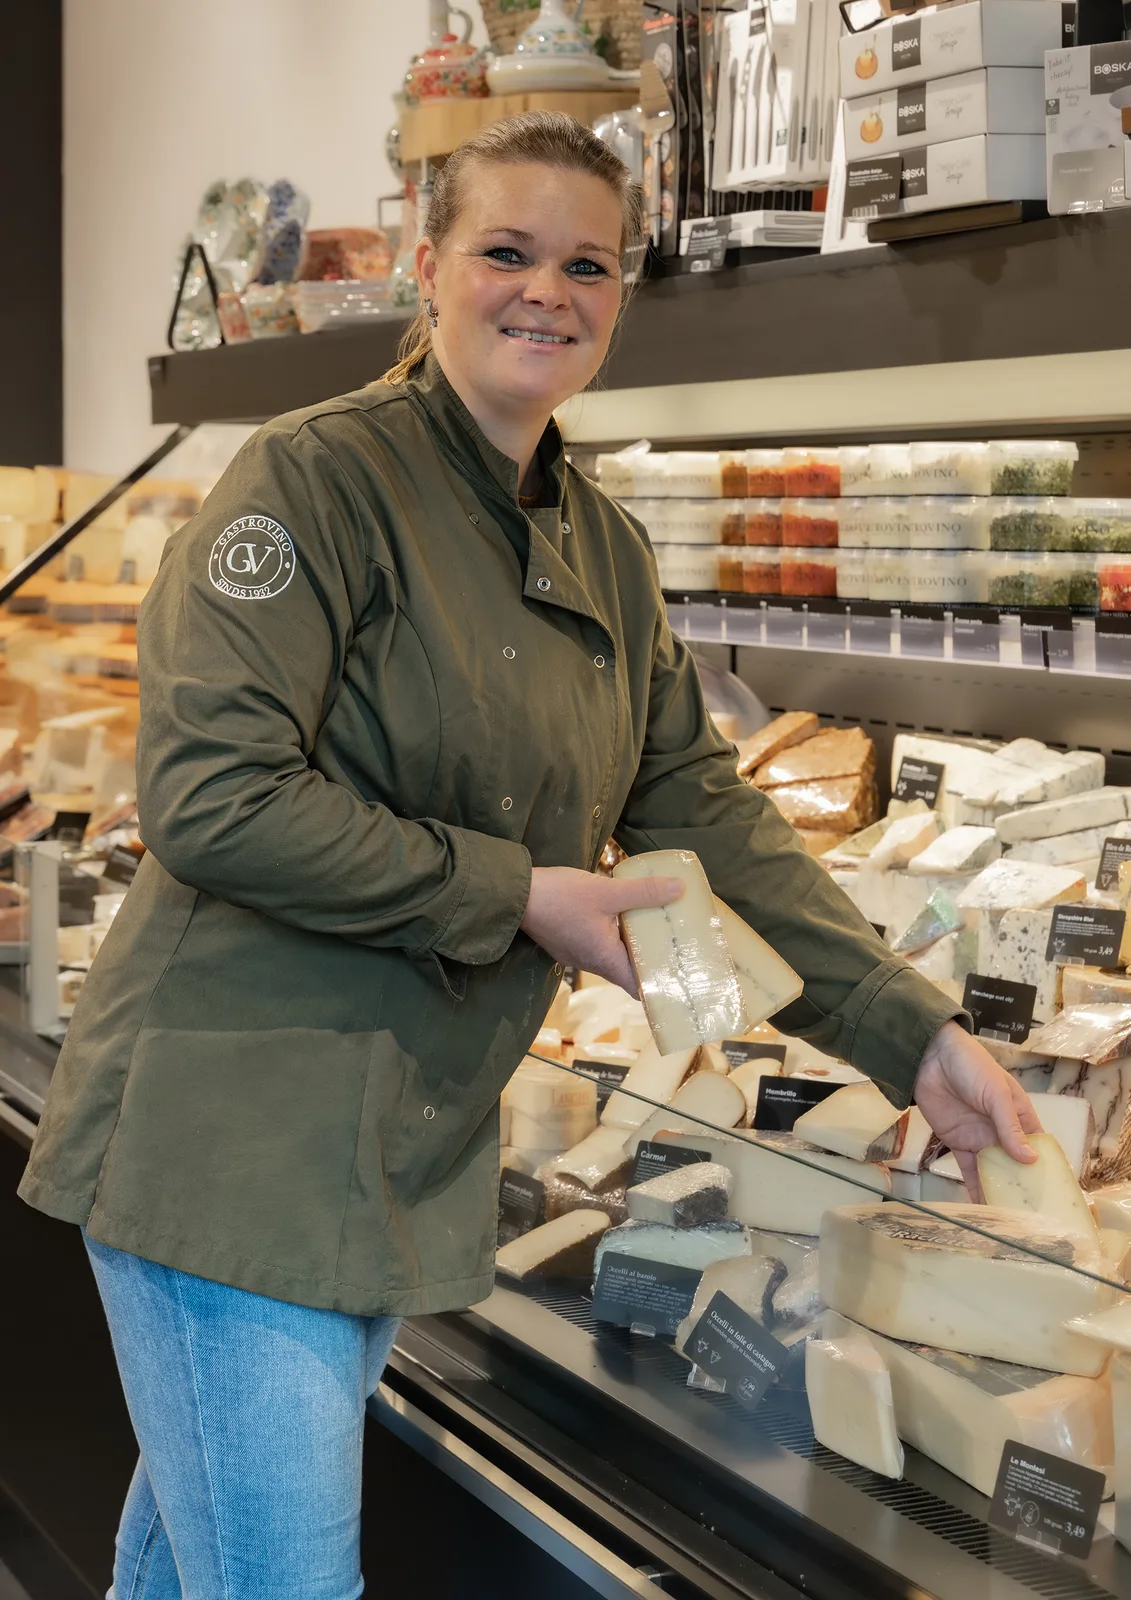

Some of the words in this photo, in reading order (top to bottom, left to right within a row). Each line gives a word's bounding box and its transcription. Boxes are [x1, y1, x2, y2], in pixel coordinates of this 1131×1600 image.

[893, 38, 919, 52] BOSKA
[898, 103, 924, 117] BOSKA
[218, 518, 292, 552] GASTROVINO
[226, 542, 275, 575] GV
[215, 577, 247, 598] SINDS
[248, 585, 272, 598] 1932
[1057, 913, 1083, 922] Shropshire
[1098, 945, 1114, 956] 3,49
[970, 989, 995, 1000] Manchego
[1010, 1021, 1025, 1032] 3,99
[765, 1088, 797, 1098] Membrillo
[640, 1150, 667, 1162] Carmel
[636, 1271, 657, 1281] barolo
[711, 1323, 728, 1339] maanden
[710, 1310, 730, 1329] Occelli
[727, 1325, 735, 1335] in
[733, 1331, 747, 1346] folie
[746, 1343, 754, 1351] di
[752, 1349, 776, 1371] castagno
[743, 1378, 756, 1391] 7,99
[1010, 1456, 1019, 1465] Le
[1064, 1521, 1085, 1538] 3,49
